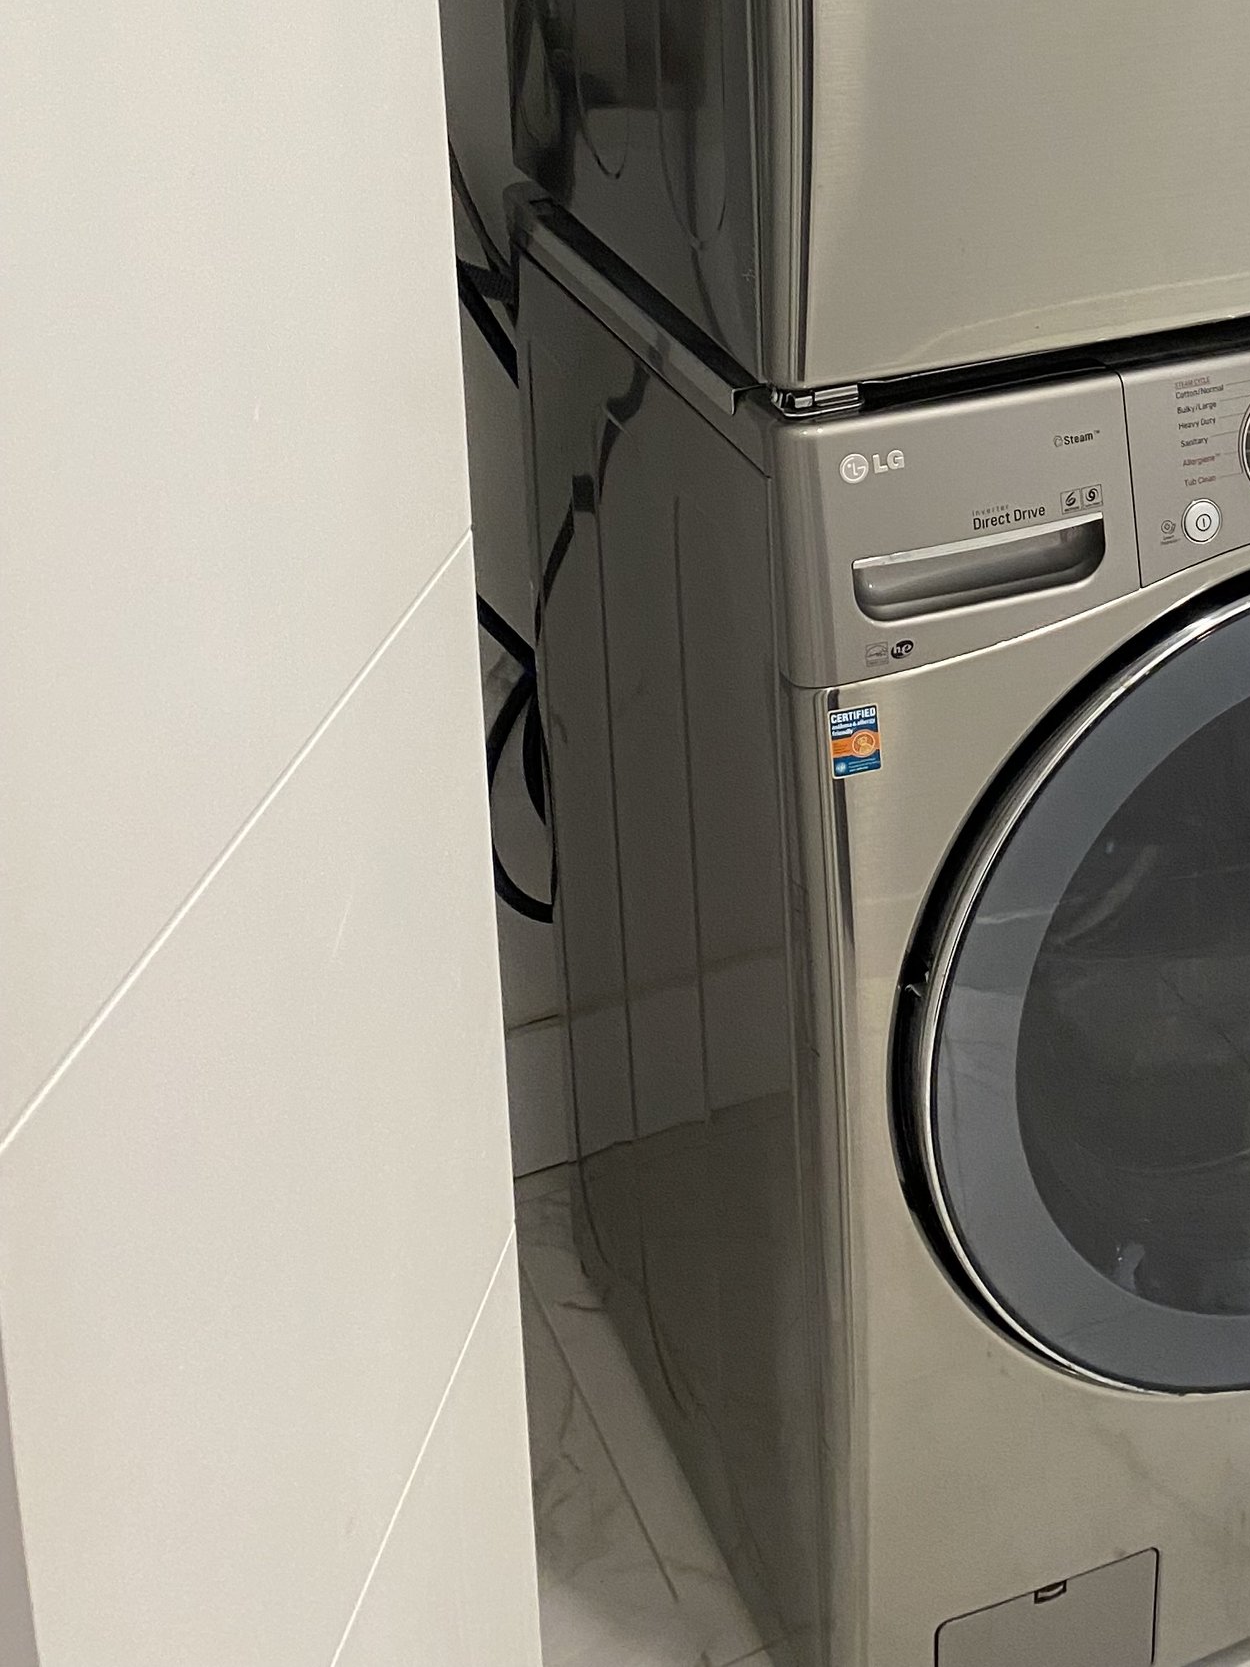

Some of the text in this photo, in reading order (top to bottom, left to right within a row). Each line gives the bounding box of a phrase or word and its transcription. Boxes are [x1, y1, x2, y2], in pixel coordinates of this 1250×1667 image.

[1175, 384, 1224, 399] Cotton/Normal
[1177, 401, 1217, 414] Bulky/Large
[1178, 417, 1216, 430] Heavy Duty
[1180, 437, 1208, 448] Sanitary
[873, 450, 905, 474] LG
[1184, 478, 1197, 487] Tub
[972, 503, 1009, 517] Inverter
[973, 506, 1046, 530] Direct Drive
[830, 707, 876, 724] CERTIFIED
